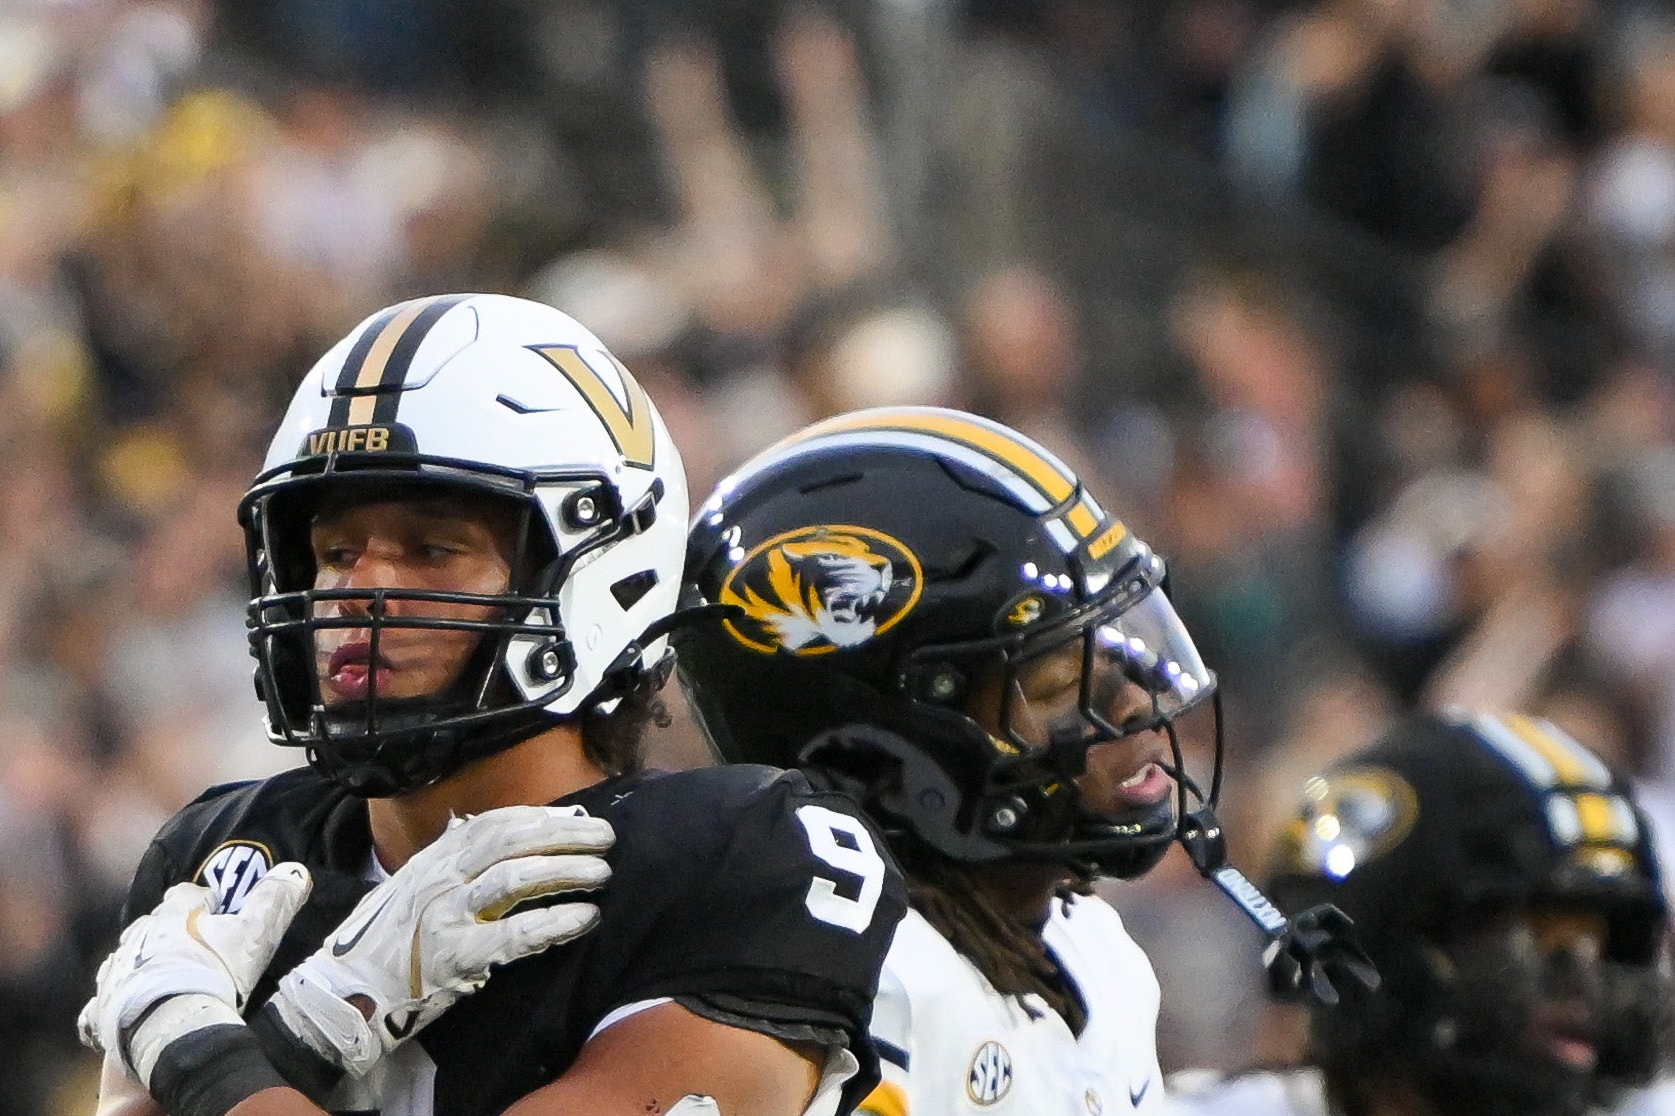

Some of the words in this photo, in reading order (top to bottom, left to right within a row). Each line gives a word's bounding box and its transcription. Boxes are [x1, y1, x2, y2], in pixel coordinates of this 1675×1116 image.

[309, 427, 390, 455] VUFB
[521, 343, 655, 472] V
[796, 804, 887, 935] 9
[969, 1041, 1013, 1105] SEC
